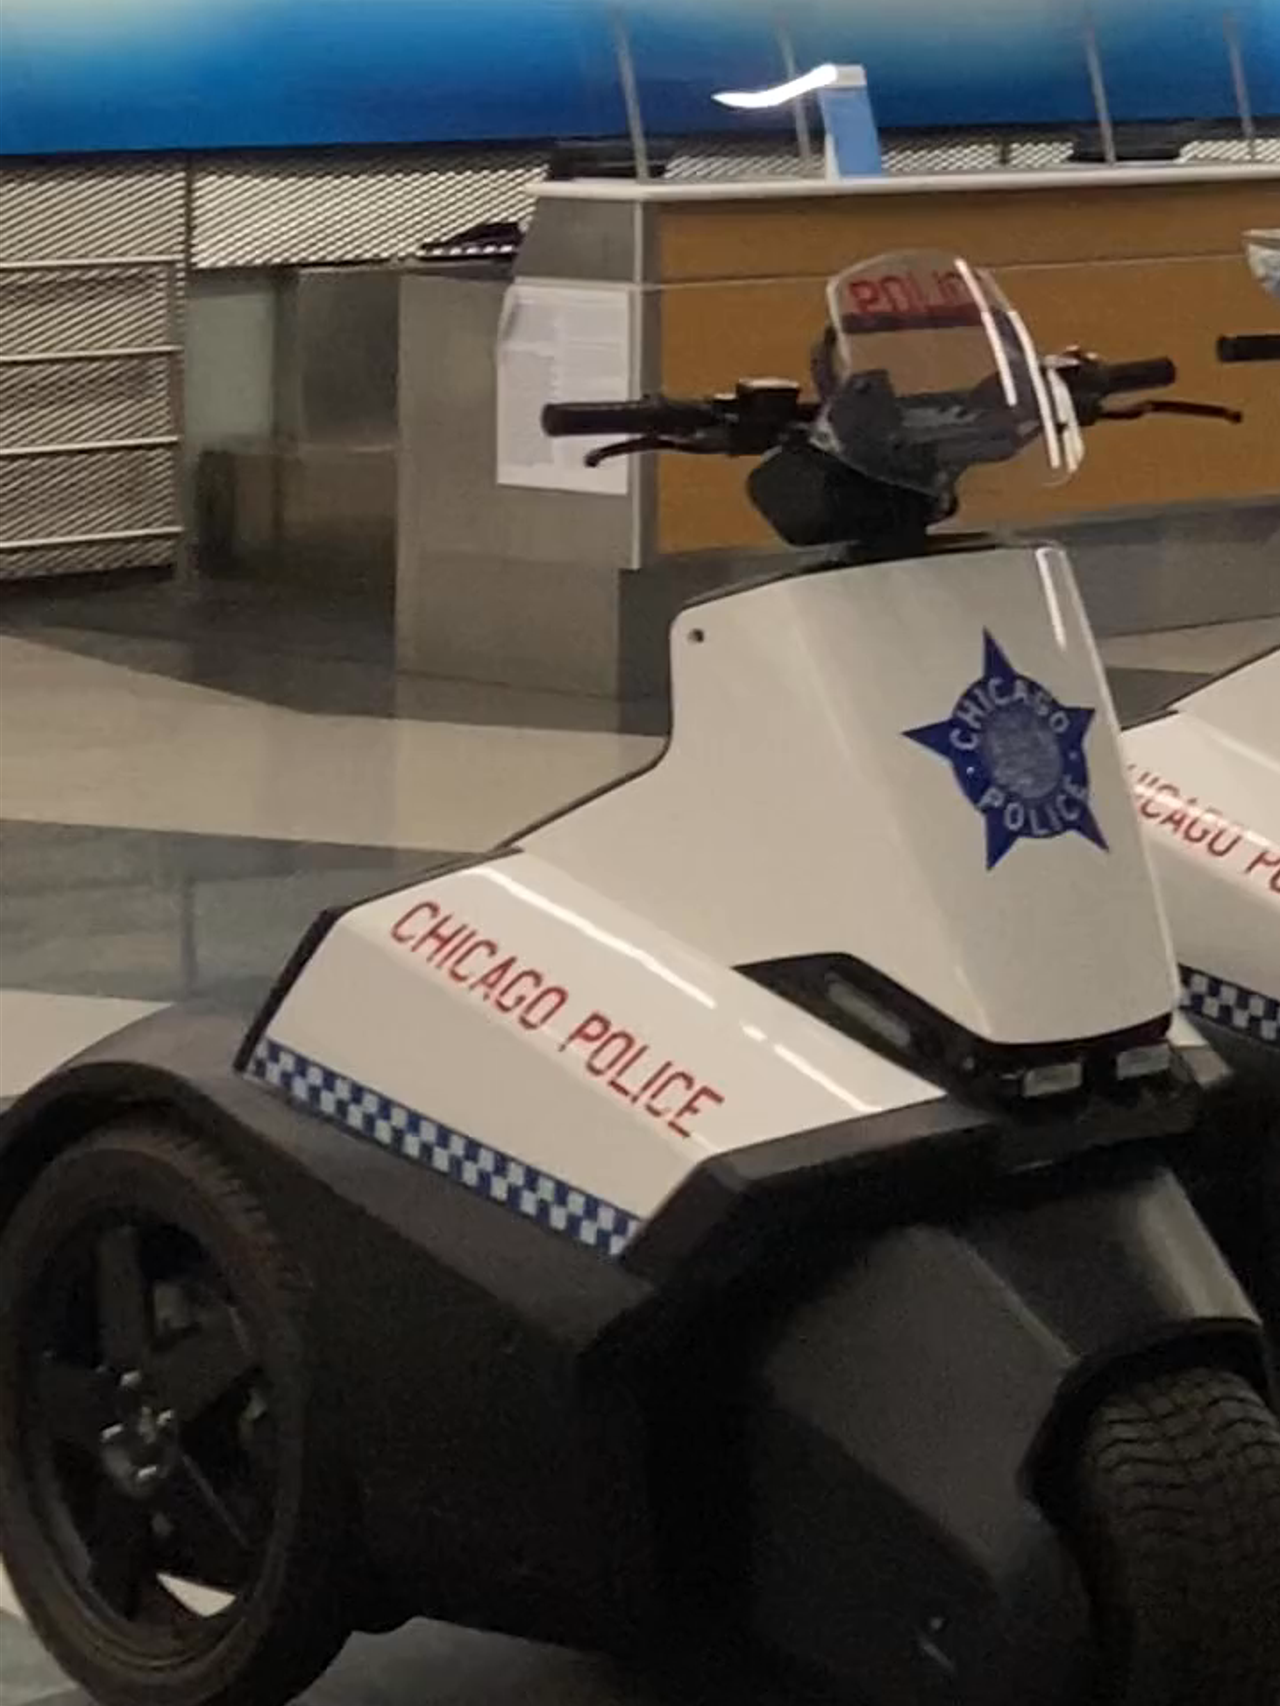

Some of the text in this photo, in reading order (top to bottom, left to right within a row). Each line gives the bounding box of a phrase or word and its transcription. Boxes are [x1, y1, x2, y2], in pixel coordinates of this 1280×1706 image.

[949, 678, 1070, 751] CHICAGO
[979, 774, 1087, 836] POLICE
[390, 900, 727, 1140] CHICAGO POLICE
